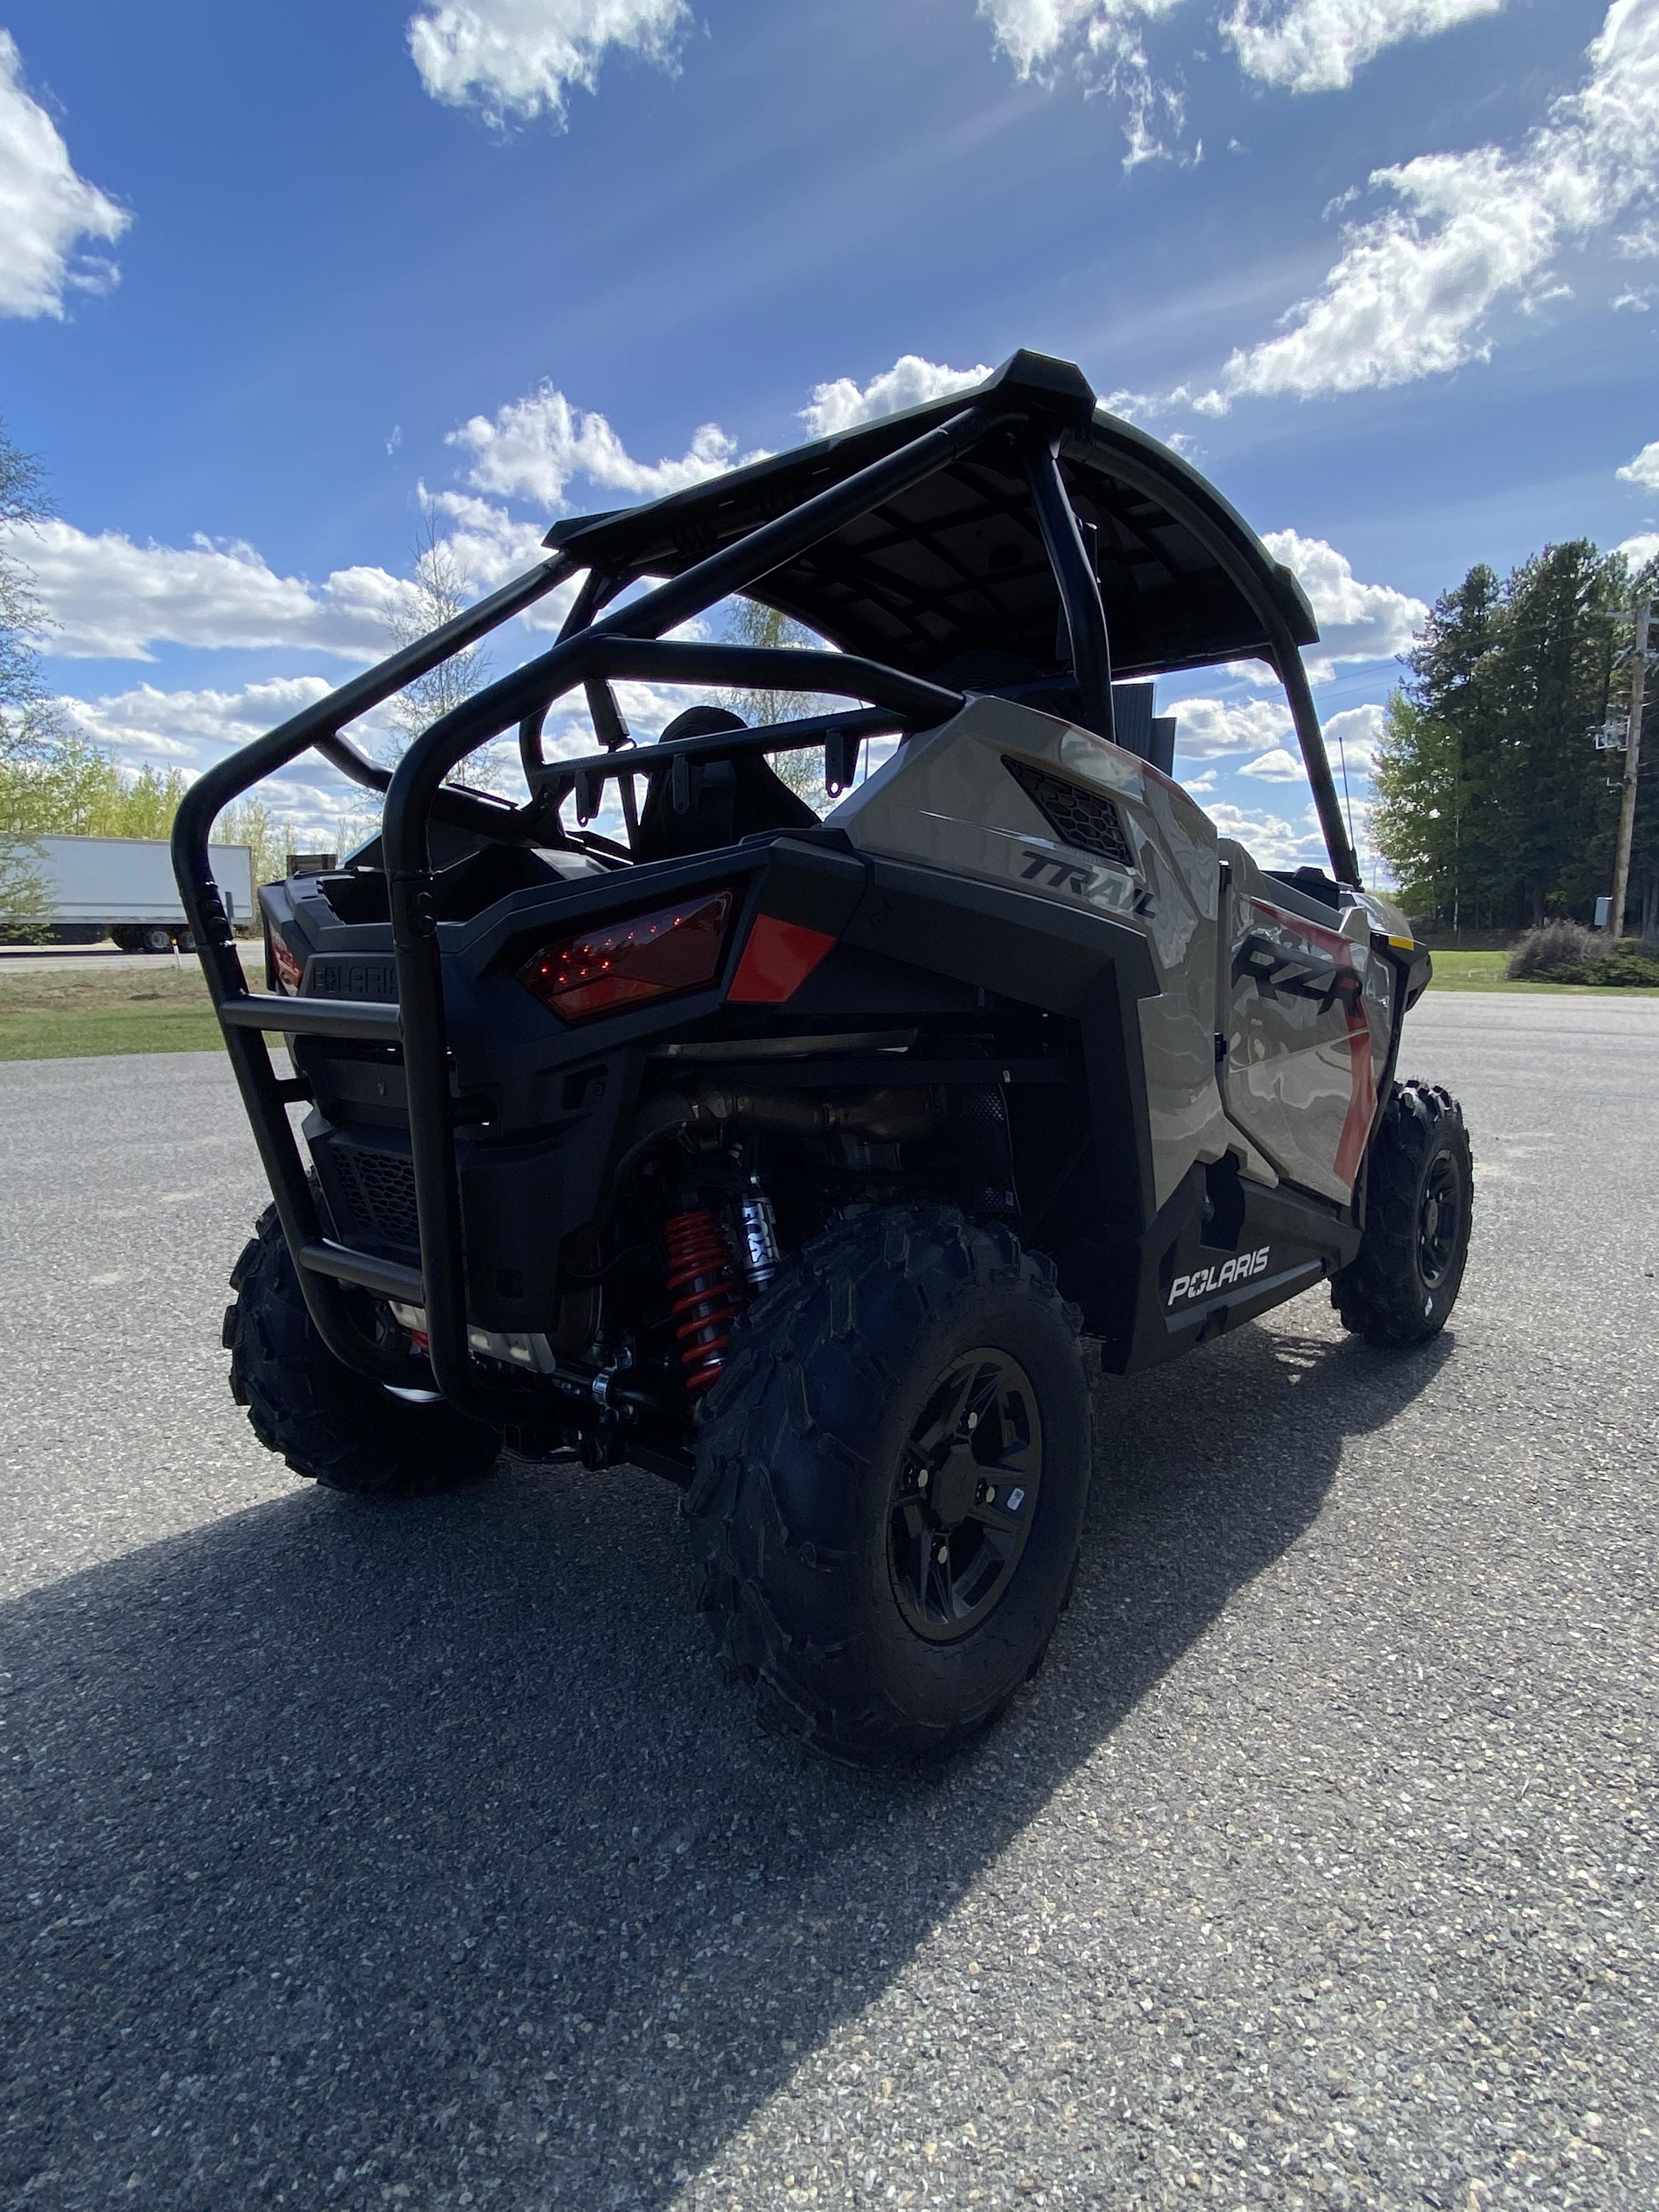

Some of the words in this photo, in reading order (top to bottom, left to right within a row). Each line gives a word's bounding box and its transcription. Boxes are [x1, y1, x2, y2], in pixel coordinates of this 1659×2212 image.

[1020, 850, 1156, 919] TRAIL
[1231, 934, 1363, 1018] RZR
[1167, 1246, 1271, 1306] POLARIS
